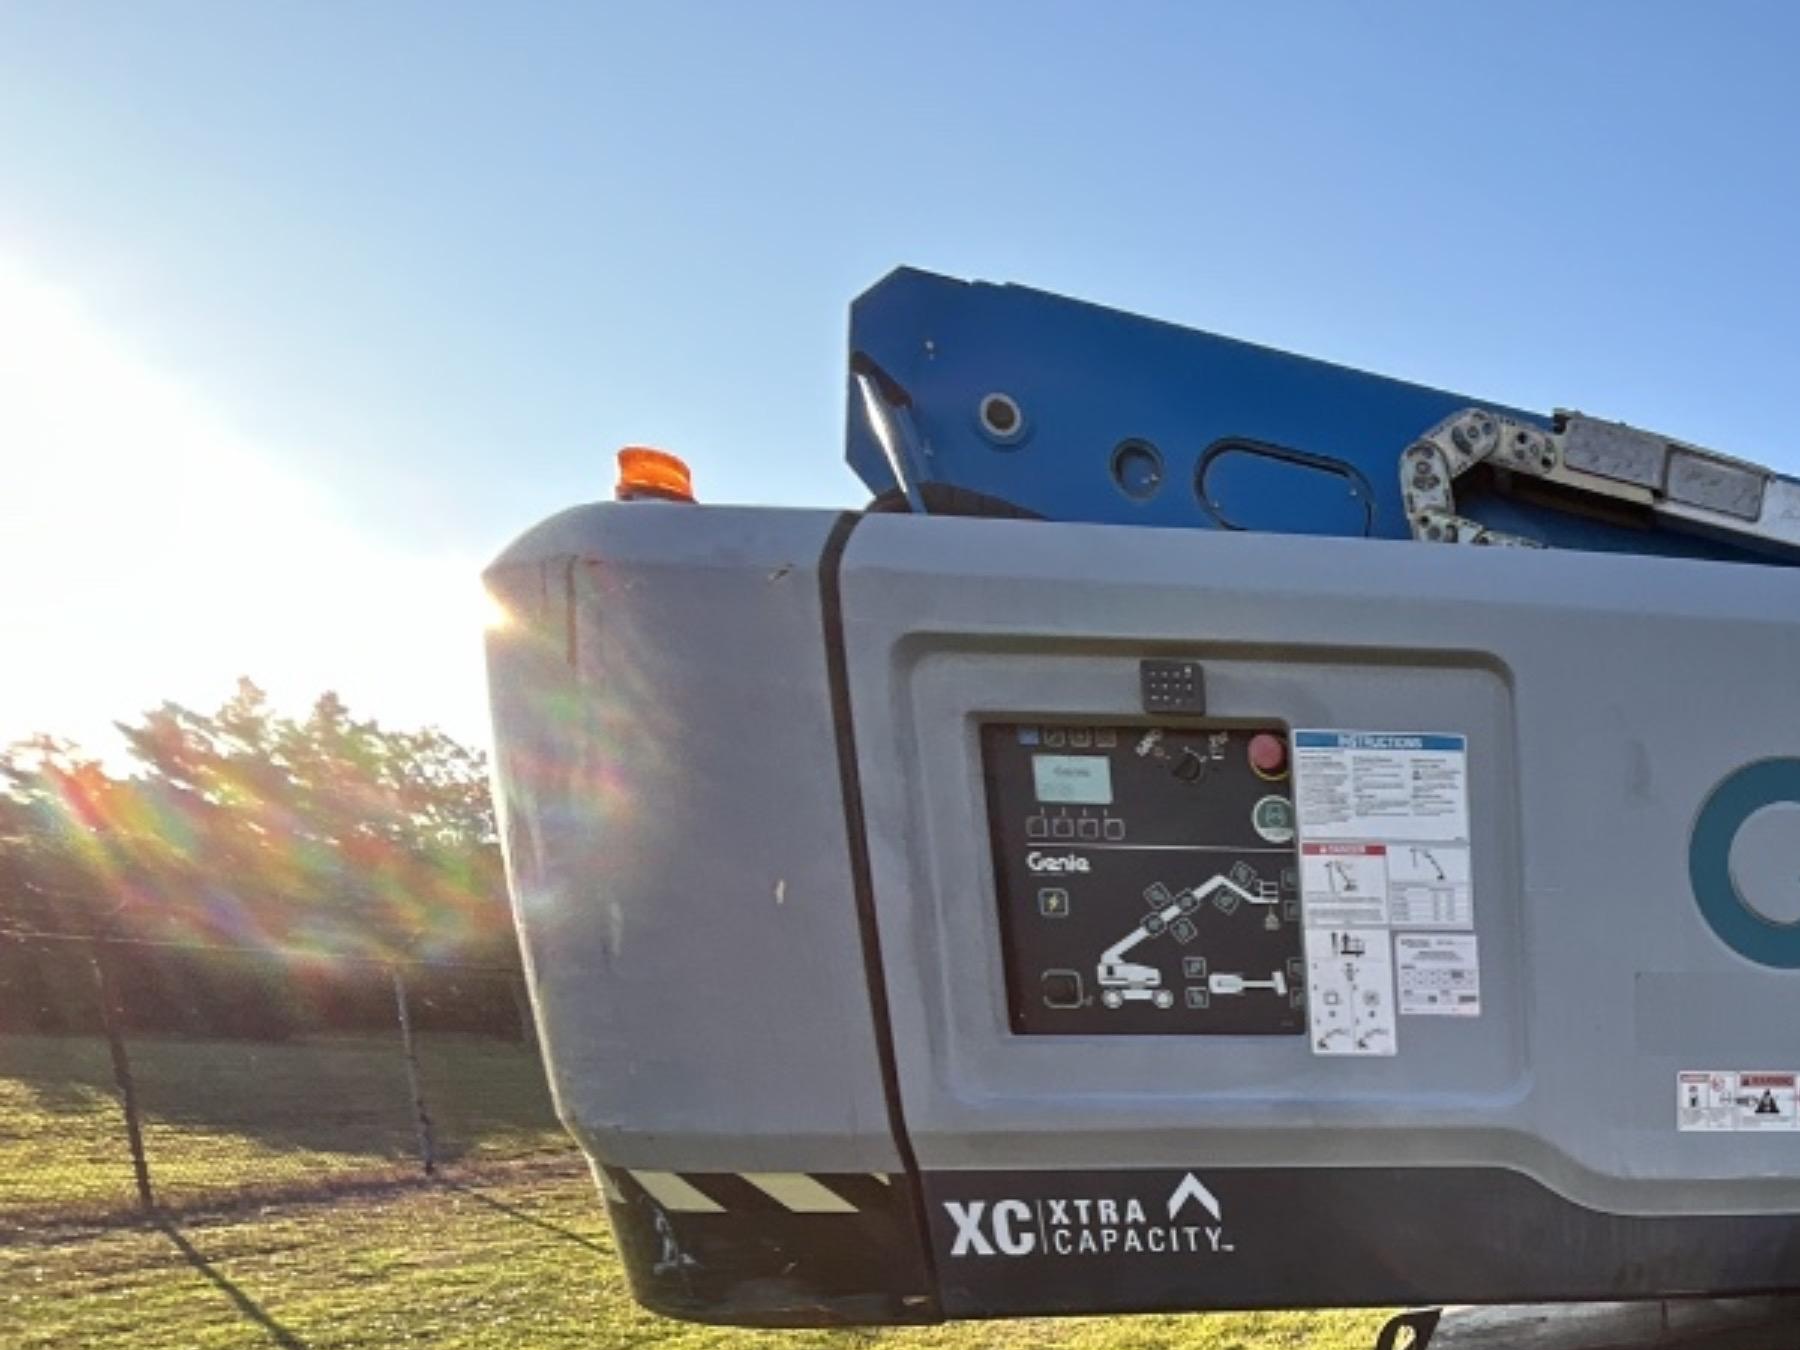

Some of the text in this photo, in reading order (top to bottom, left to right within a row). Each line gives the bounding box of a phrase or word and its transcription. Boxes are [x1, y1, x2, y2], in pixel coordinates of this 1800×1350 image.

[1026, 851, 1091, 872] Genie
[1048, 1199, 1147, 1225] XTRA
[942, 1200, 1036, 1256] XC
